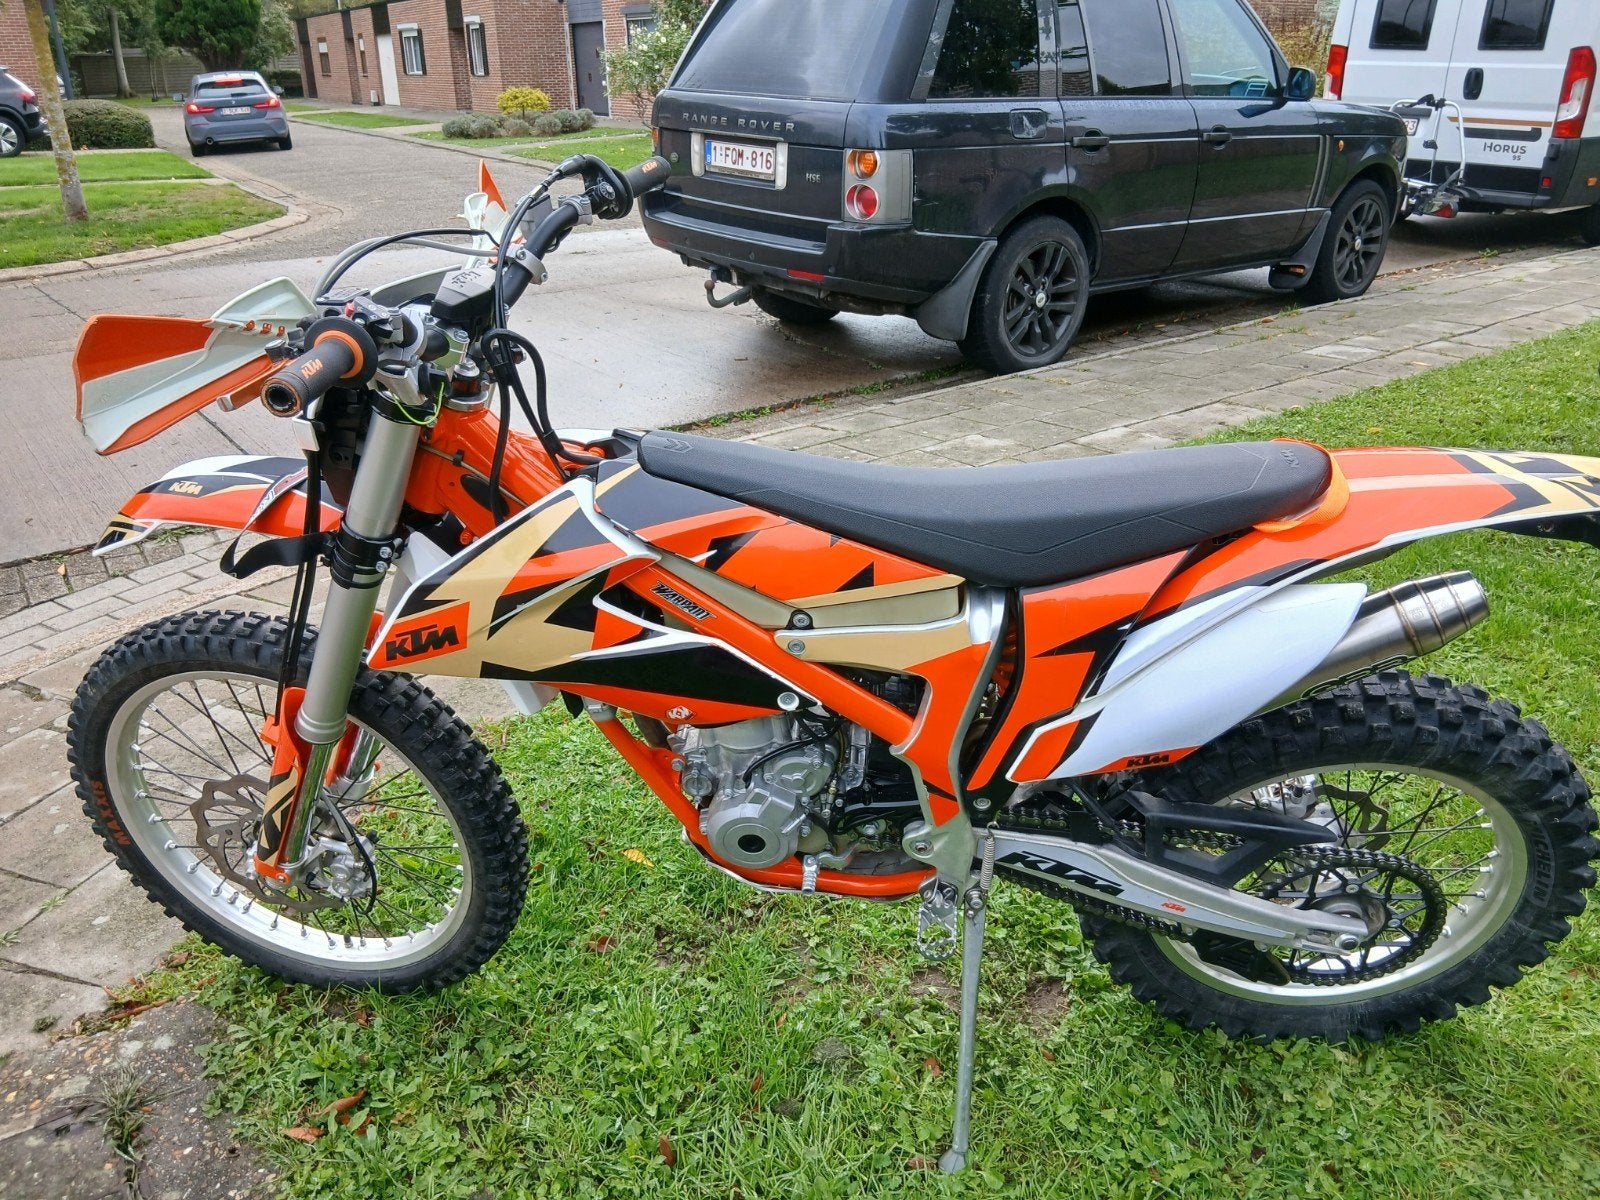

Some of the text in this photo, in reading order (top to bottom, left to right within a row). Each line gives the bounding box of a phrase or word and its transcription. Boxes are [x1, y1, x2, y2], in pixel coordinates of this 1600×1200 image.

[682, 112, 795, 132] RANGE ROVER
[1483, 142, 1527, 155] HORUS
[806, 173, 821, 183] HSE
[301, 358, 323, 379] KTM
[168, 480, 203, 496] KTM
[386, 624, 460, 662] KTM
[1126, 754, 1170, 767] KTM
[999, 851, 1125, 897] KTM
[1161, 902, 1186, 912] KTM
